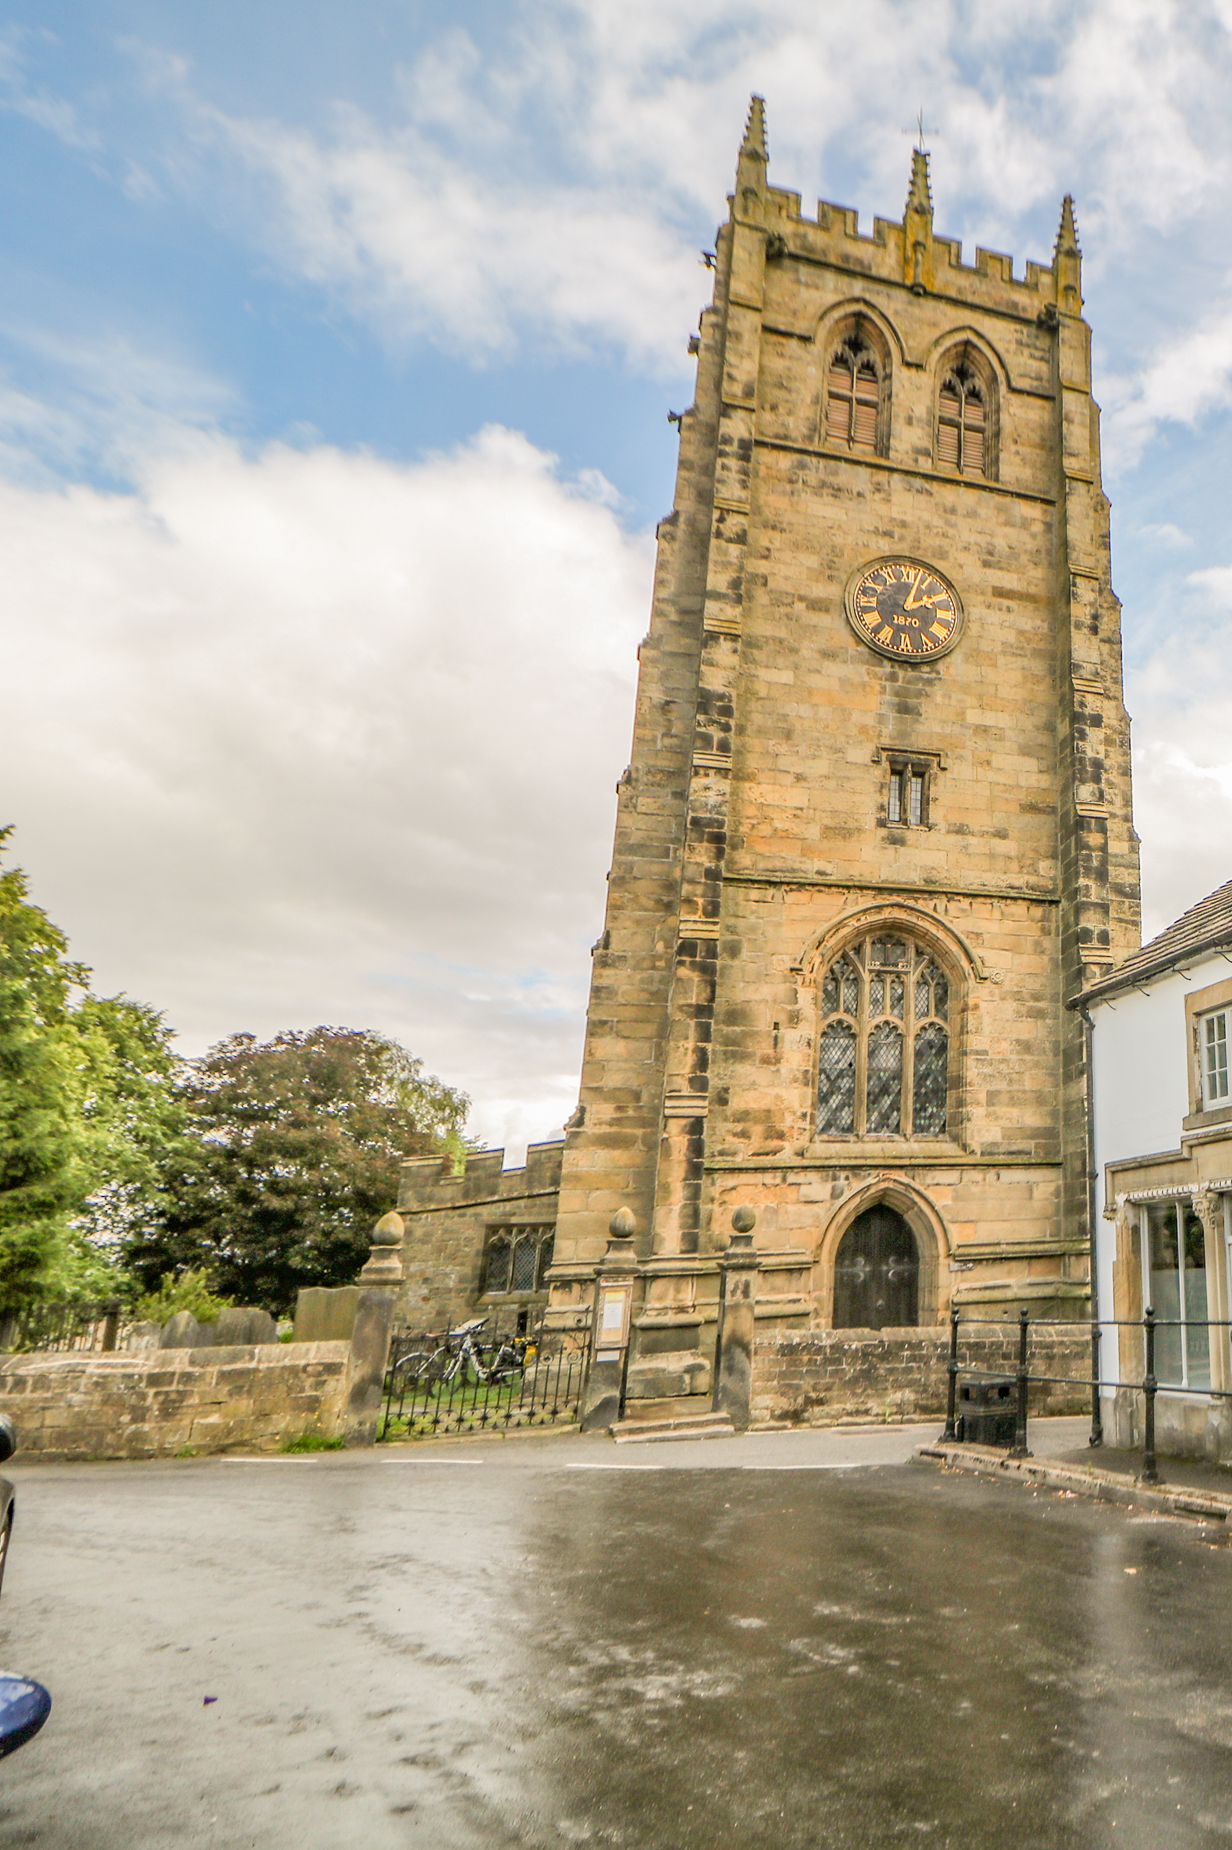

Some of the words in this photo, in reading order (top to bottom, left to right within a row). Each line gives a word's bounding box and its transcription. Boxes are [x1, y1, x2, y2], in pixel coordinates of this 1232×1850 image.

[880, 567, 898, 585] XI
[900, 567, 916, 583] XII
[920, 576, 932, 590] I
[865, 577, 884, 593] X
[860, 595, 878, 608] IX
[863, 610, 882, 628] VIII
[892, 614, 920, 628] 1870
[937, 608, 952, 621] III
[877, 624, 895, 643] VII
[899, 632, 914, 650] VI
[920, 632, 934, 648] V
